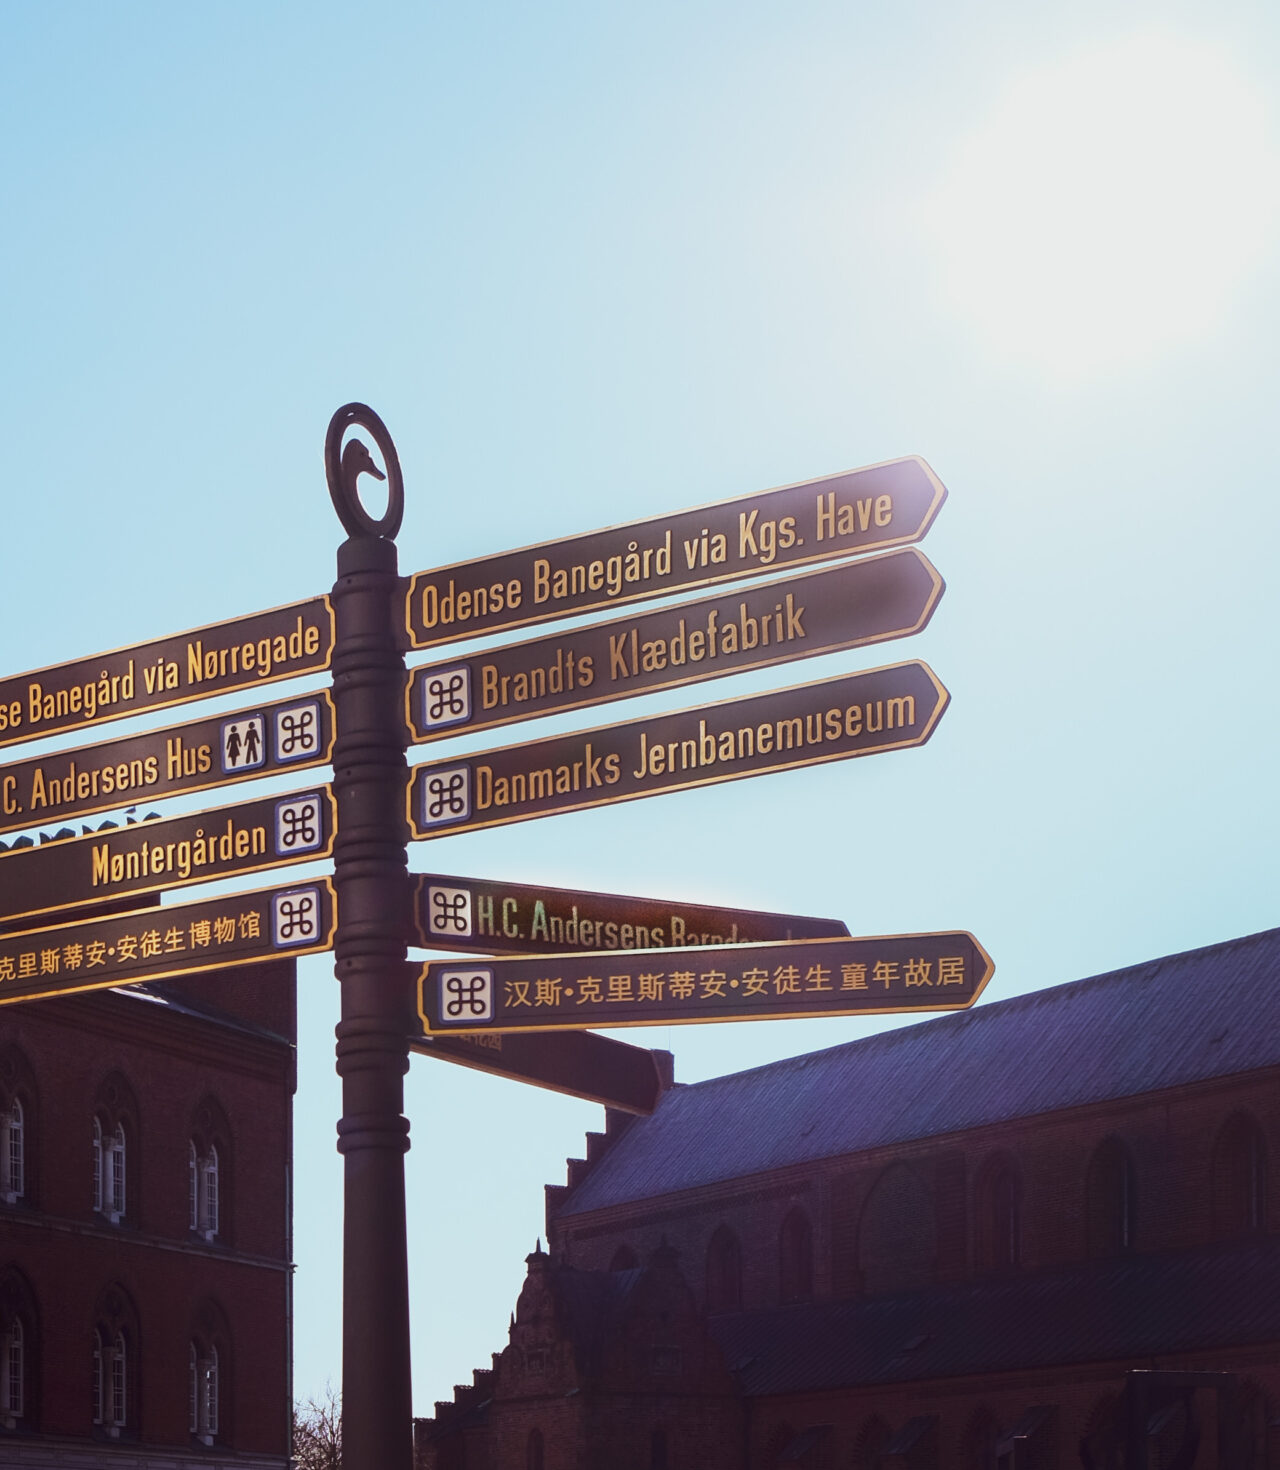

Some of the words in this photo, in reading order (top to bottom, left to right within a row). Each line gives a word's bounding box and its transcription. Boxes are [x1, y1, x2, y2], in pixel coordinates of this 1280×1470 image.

[422, 579, 522, 629] Odense
[534, 529, 672, 604] Banegård
[683, 528, 727, 570] via
[739, 509, 804, 561] Kgs.
[816, 489, 894, 541] Have
[28, 659, 134, 723] Banegård
[143, 657, 179, 695] via
[187, 615, 319, 685] Nørregade
[481, 650, 594, 710] Brandts
[609, 593, 806, 680] Klædefabrik
[30, 756, 158, 810] Andersens
[166, 737, 211, 780] Hus
[476, 743, 621, 810] Danmarks
[633, 695, 915, 779] Jernbanemuseum
[92, 820, 266, 886] Møntergården
[531, 899, 665, 947] Andersens
